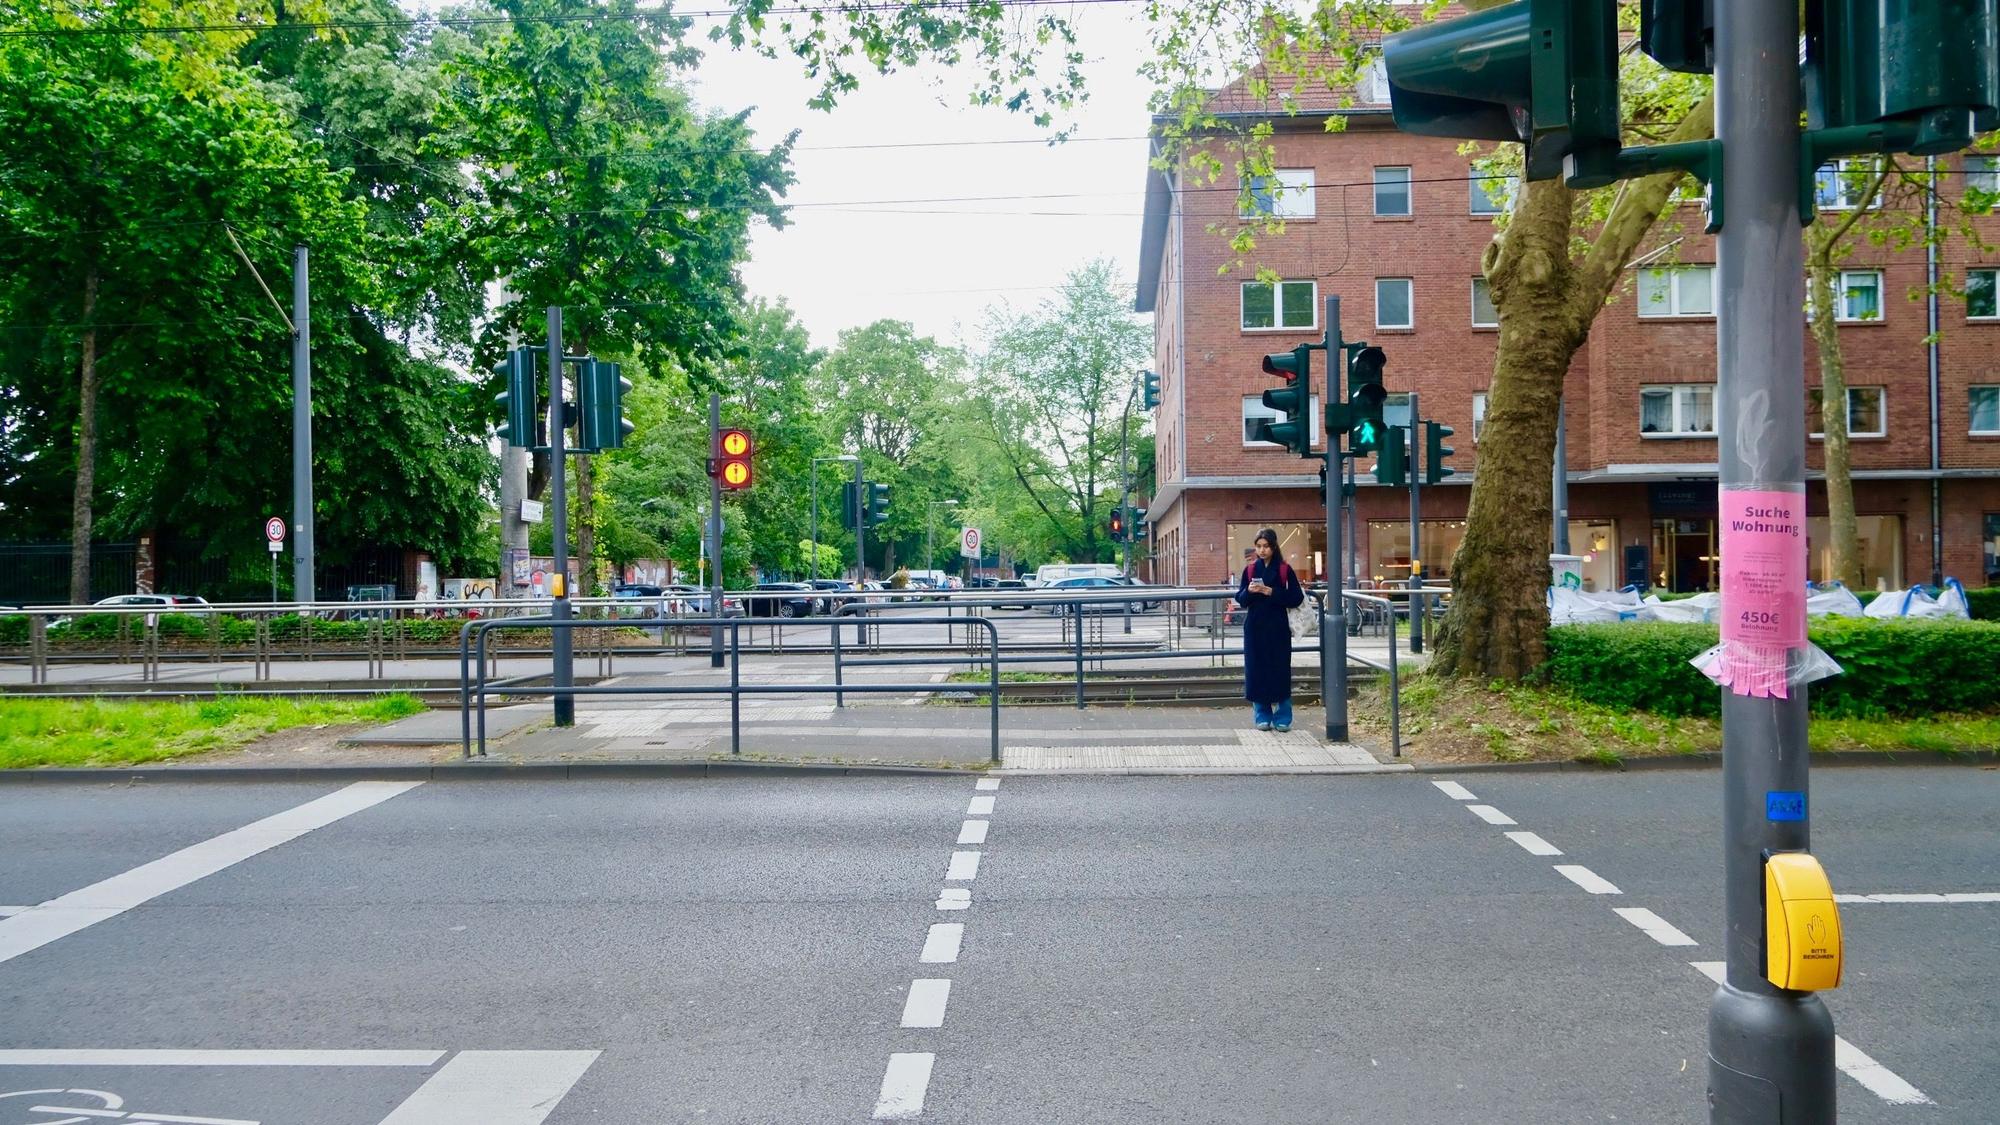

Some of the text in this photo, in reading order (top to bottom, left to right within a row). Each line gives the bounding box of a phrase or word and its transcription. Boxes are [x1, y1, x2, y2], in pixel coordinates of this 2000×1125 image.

[1745, 506, 1791, 519] Suche
[271, 525, 281, 536] 30
[1732, 520, 1799, 537] Wohnung
[968, 534, 976, 545] 30
[1741, 611, 1780, 625] 450€
[1741, 623, 1778, 633] Belohnung
